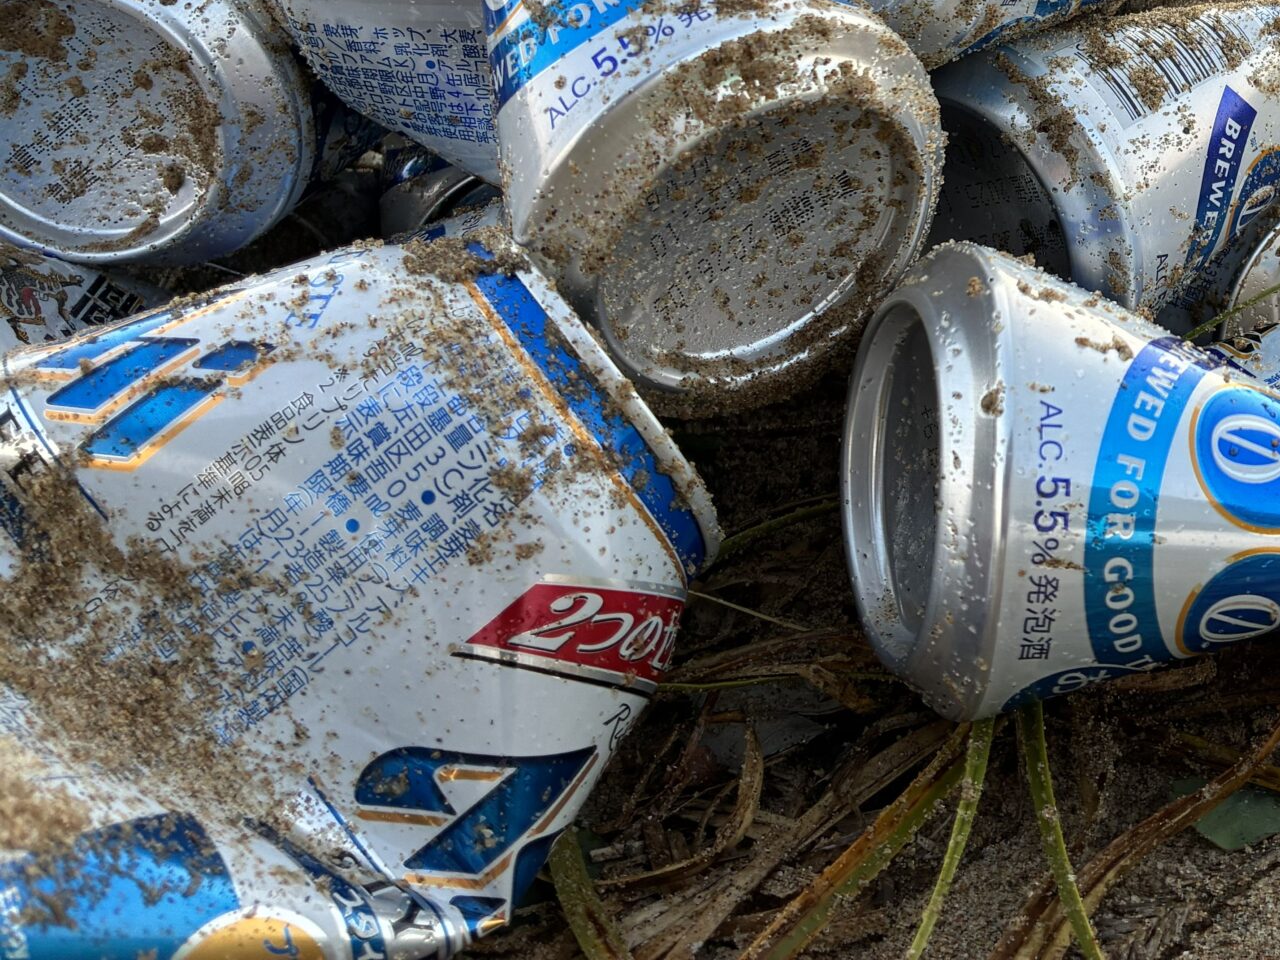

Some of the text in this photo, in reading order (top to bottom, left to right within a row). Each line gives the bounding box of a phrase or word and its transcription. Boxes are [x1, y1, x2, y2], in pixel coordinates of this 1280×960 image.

[546, 73, 598, 130] ALC.
[1200, 115, 1243, 240] BREWED
[1017, 399, 1072, 662] ALC. 5.5% 発泡酒
[1106, 452, 1147, 542] FOR
[1103, 555, 1142, 655] GOOD
